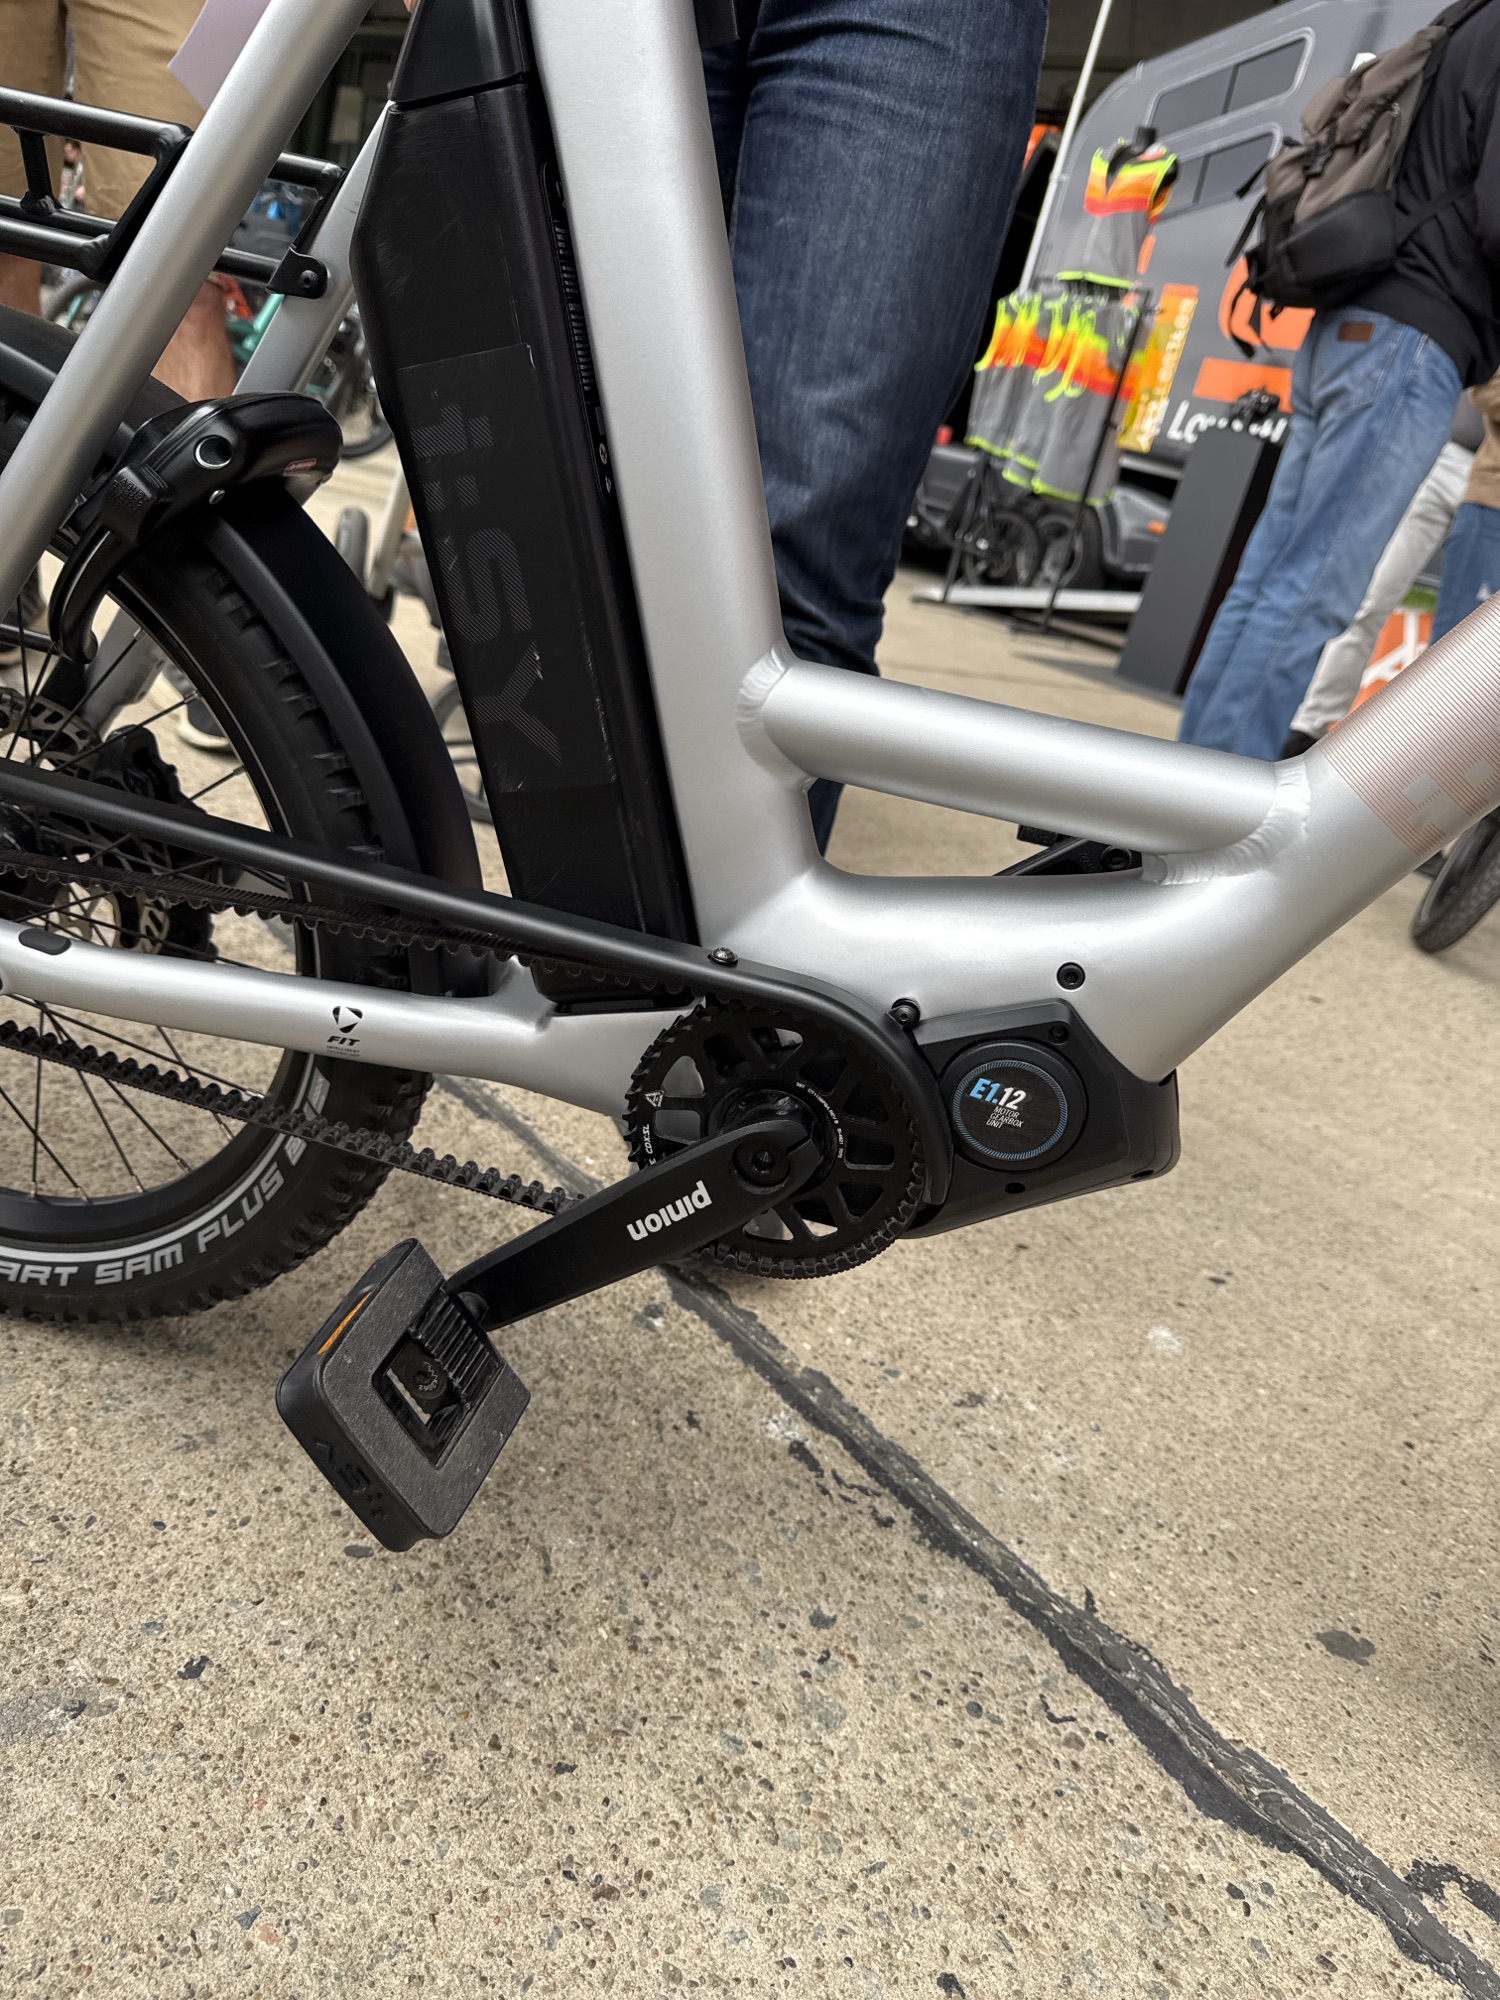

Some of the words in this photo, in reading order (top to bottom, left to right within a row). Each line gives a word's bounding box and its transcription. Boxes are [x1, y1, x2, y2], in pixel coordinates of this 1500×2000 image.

[327, 1035, 361, 1047] FIT
[969, 1077, 1027, 1110] E1.12
[993, 1106, 1020, 1119] MOTOR
[986, 1119, 1006, 1129] UNIT
[989, 1113, 1024, 1129] GEARBOX
[626, 1179, 713, 1242] pinion
[94, 1242, 184, 1286] SAM
[197, 1161, 286, 1254] PLUS
